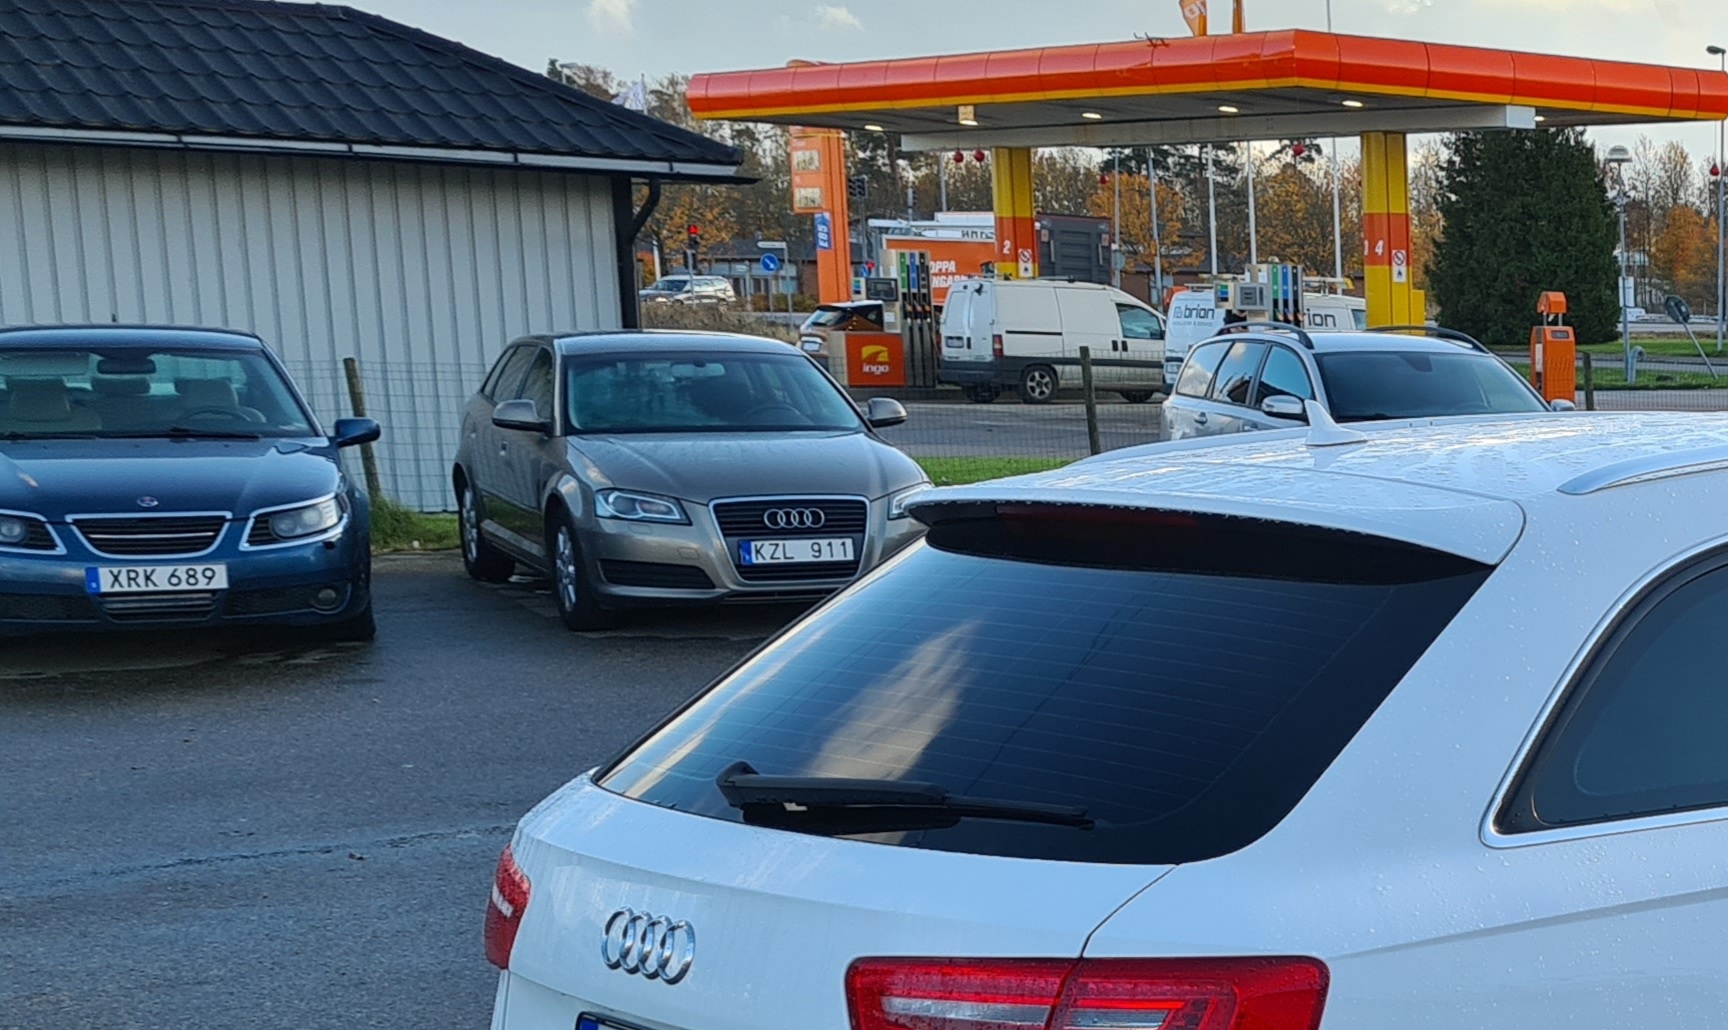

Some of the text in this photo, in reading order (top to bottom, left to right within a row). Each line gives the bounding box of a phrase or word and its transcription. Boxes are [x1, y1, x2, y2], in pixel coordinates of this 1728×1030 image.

[1002, 240, 1012, 255] 2
[1374, 239, 1384, 256] 4
[1184, 304, 1215, 320] brion
[862, 363, 890, 376] ingo
[754, 540, 848, 561] KZL 911
[108, 567, 217, 588] XRK 689
